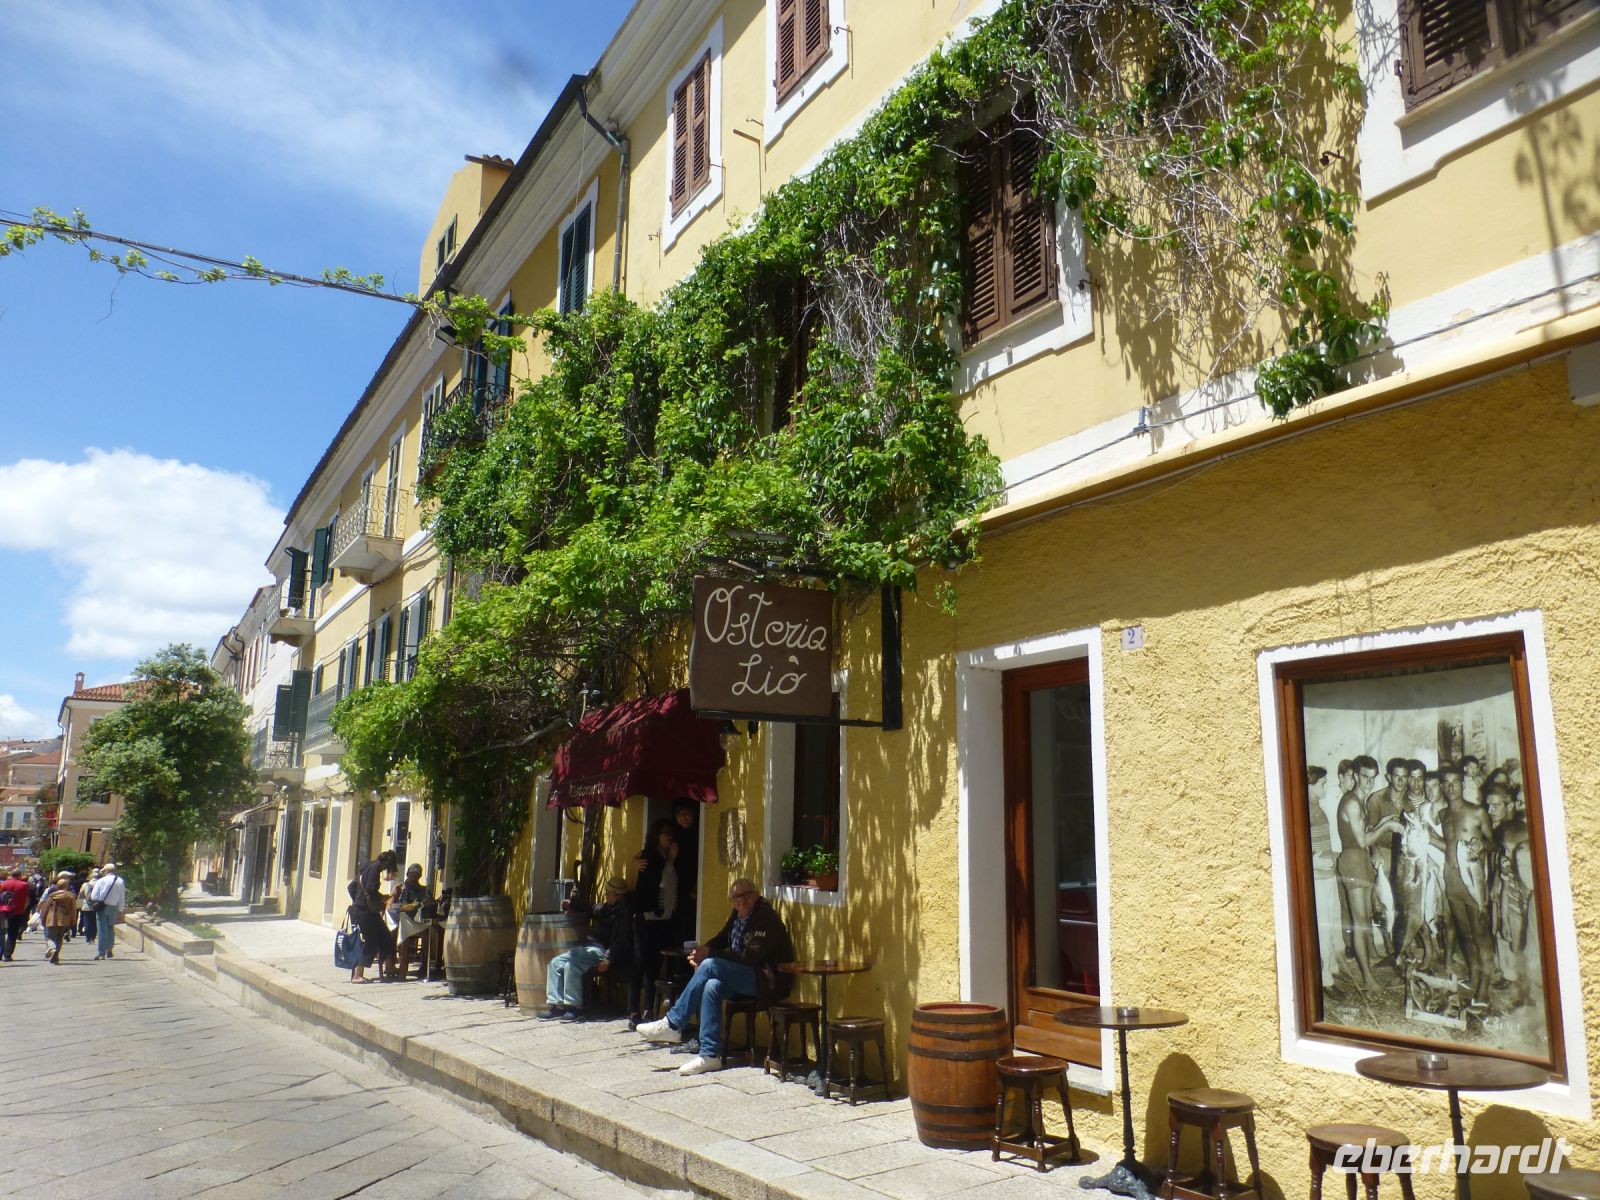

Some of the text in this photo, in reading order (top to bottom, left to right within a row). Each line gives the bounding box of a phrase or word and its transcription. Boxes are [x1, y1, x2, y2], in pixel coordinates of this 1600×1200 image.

[704, 585, 827, 651] Osteria
[1127, 628, 1136, 645] 2
[731, 653, 808, 696] Liò
